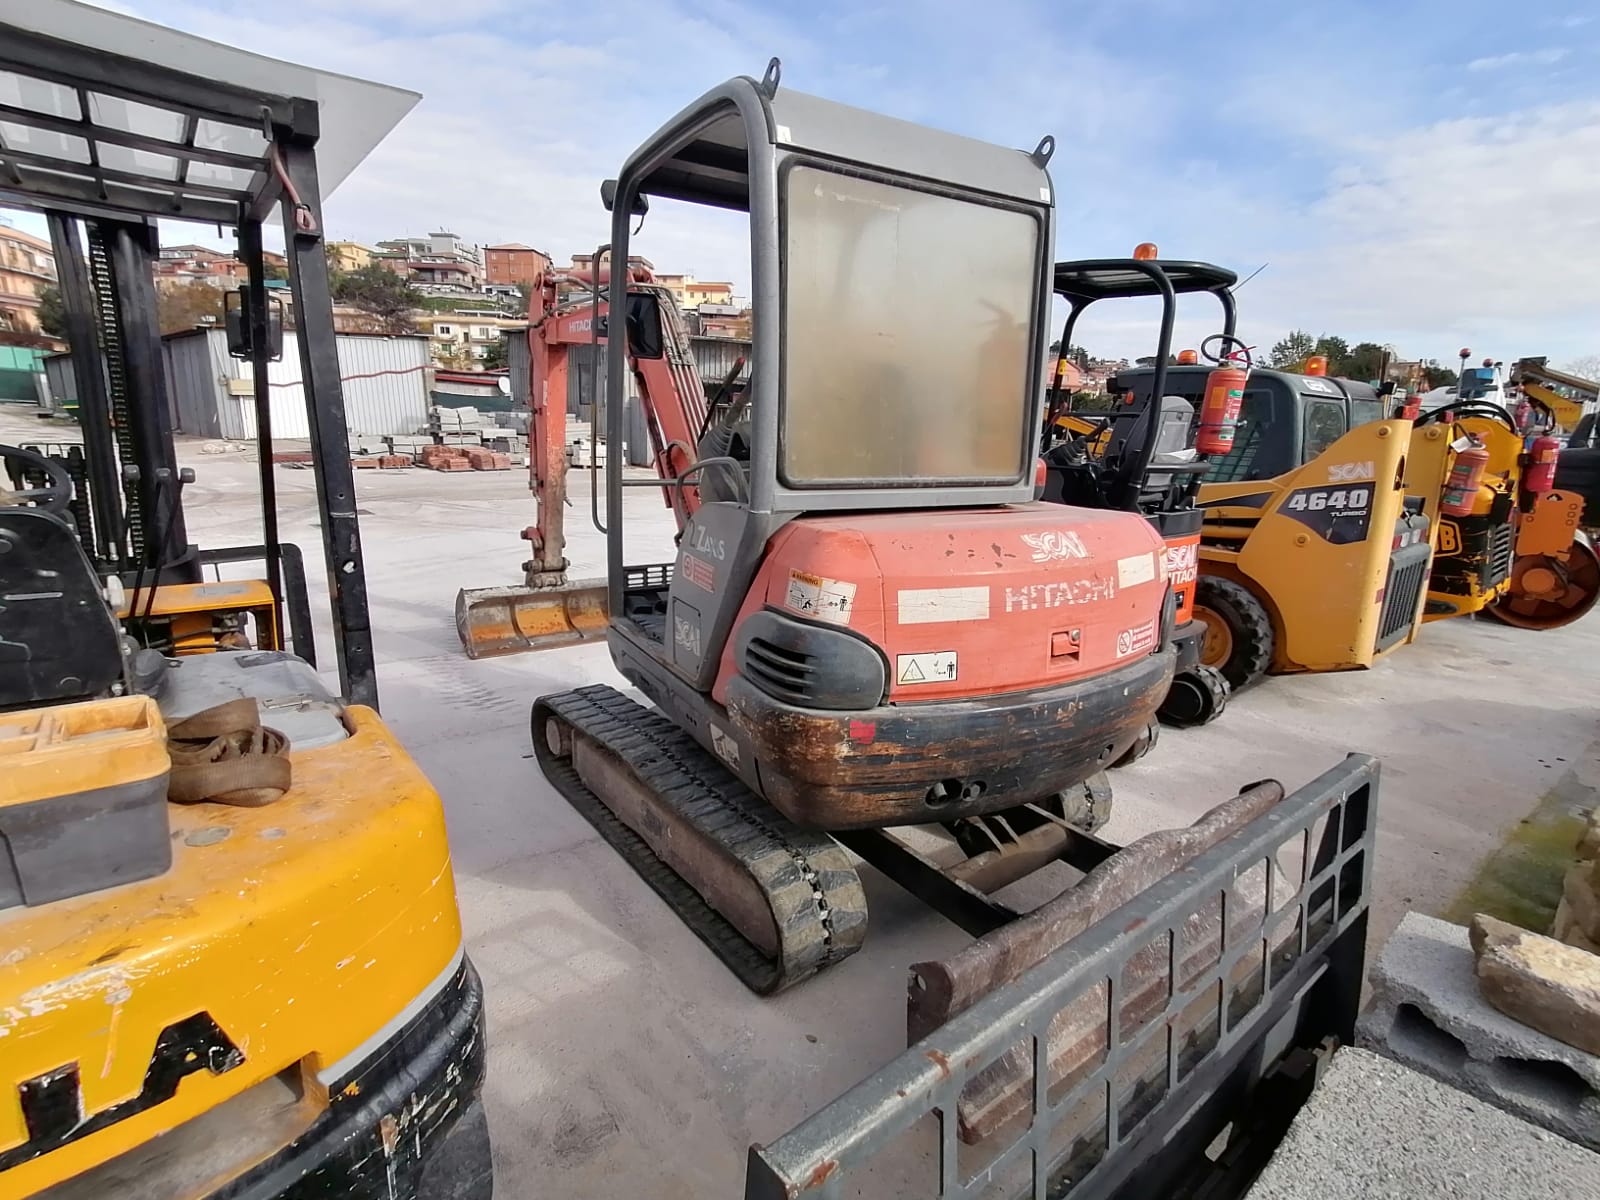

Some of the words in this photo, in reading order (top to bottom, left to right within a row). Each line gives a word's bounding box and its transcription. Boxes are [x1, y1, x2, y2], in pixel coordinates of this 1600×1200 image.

[1328, 461, 1375, 482] SCAI
[1288, 489, 1369, 511] 4640
[1329, 509, 1368, 517] TURBO
[1005, 576, 1114, 612] HITACHI
